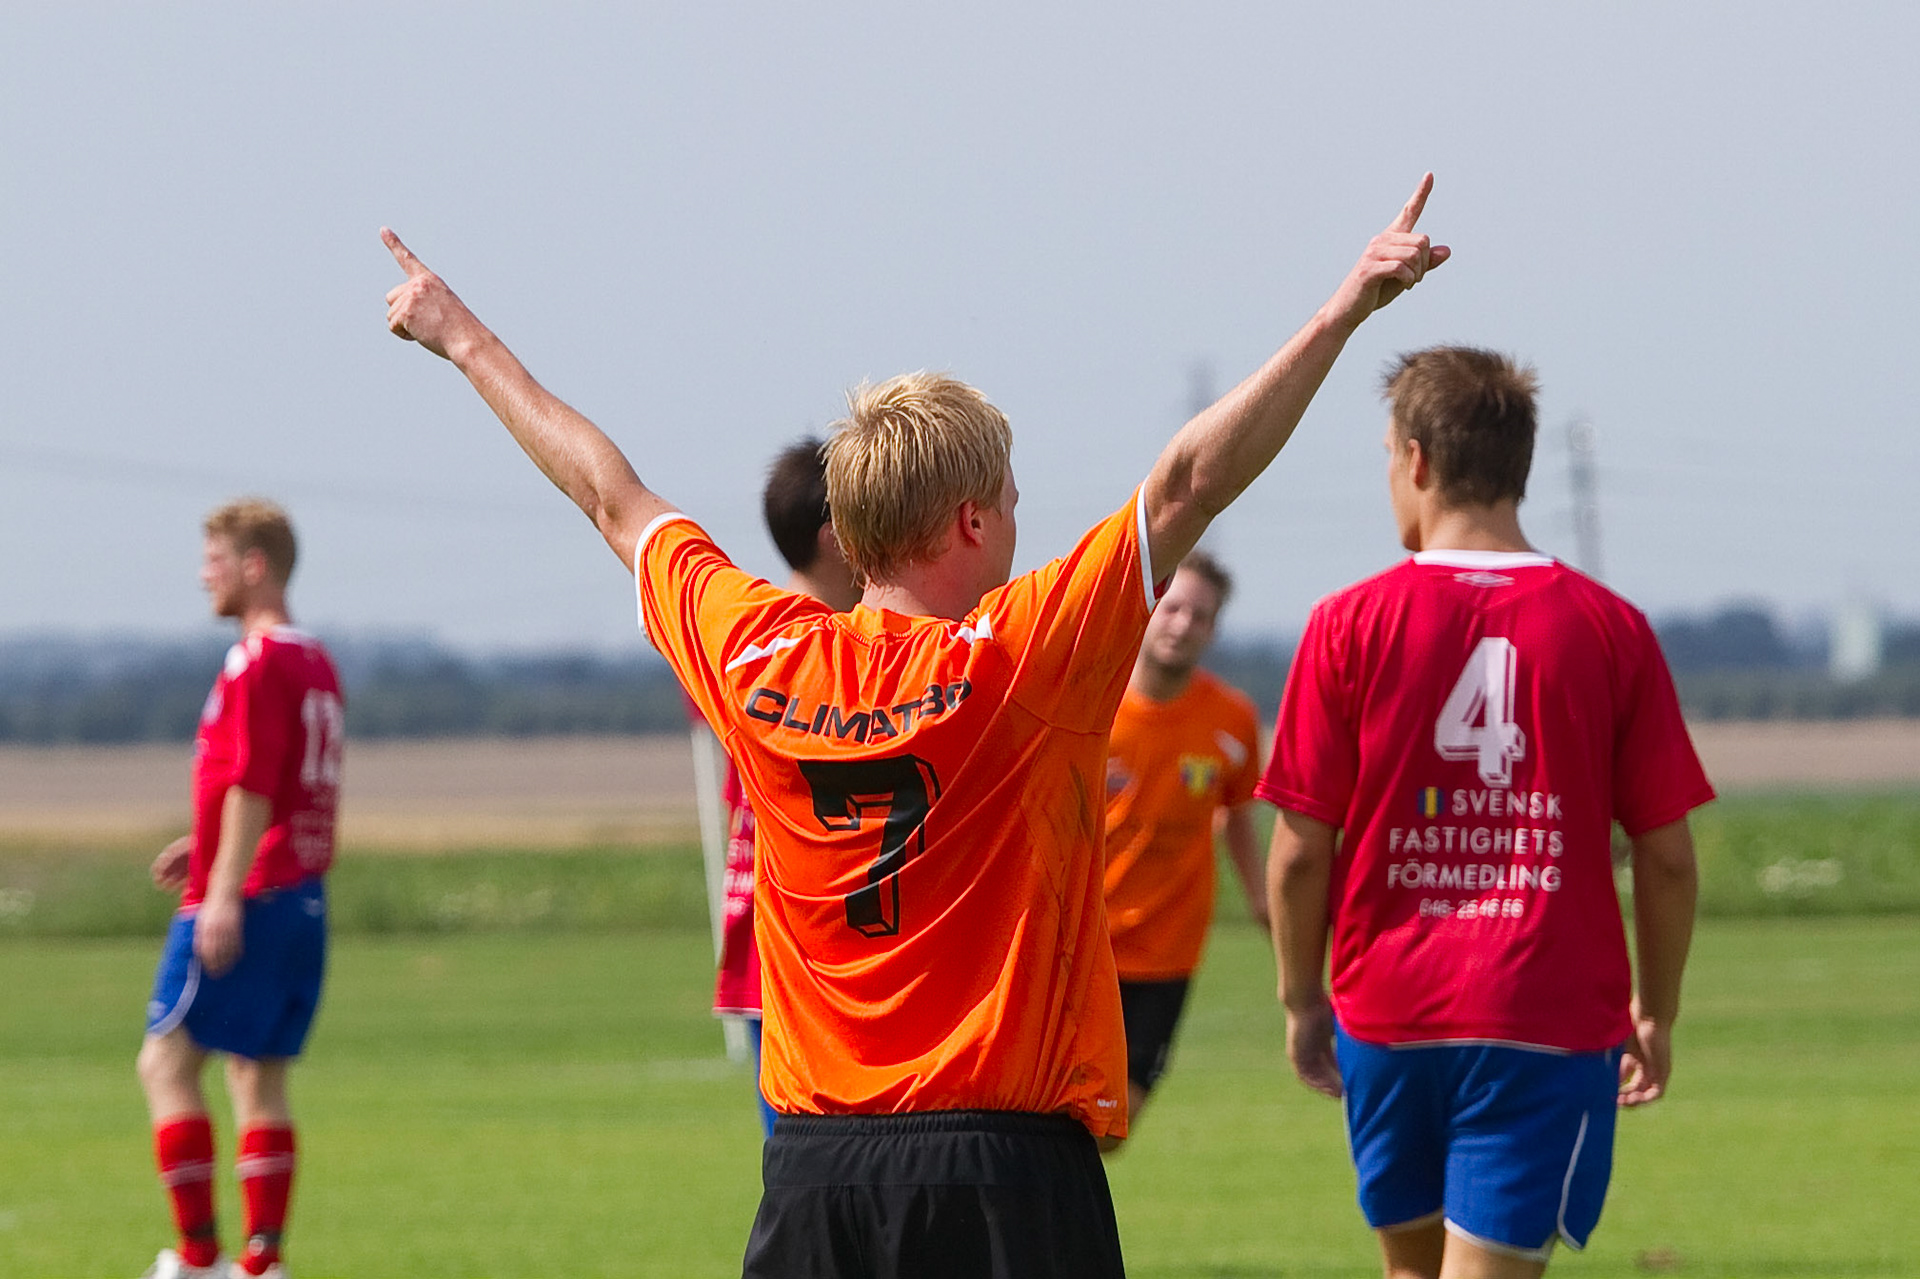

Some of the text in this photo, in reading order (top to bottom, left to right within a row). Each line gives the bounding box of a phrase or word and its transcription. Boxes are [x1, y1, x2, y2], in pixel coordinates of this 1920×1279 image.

[1434, 636, 1526, 789] 4
[1451, 788, 1564, 821] SVENSK
[796, 753, 942, 939] 7
[1388, 825, 1565, 858] FASTIGHETS
[1387, 857, 1563, 892] FÖRMEDLING
